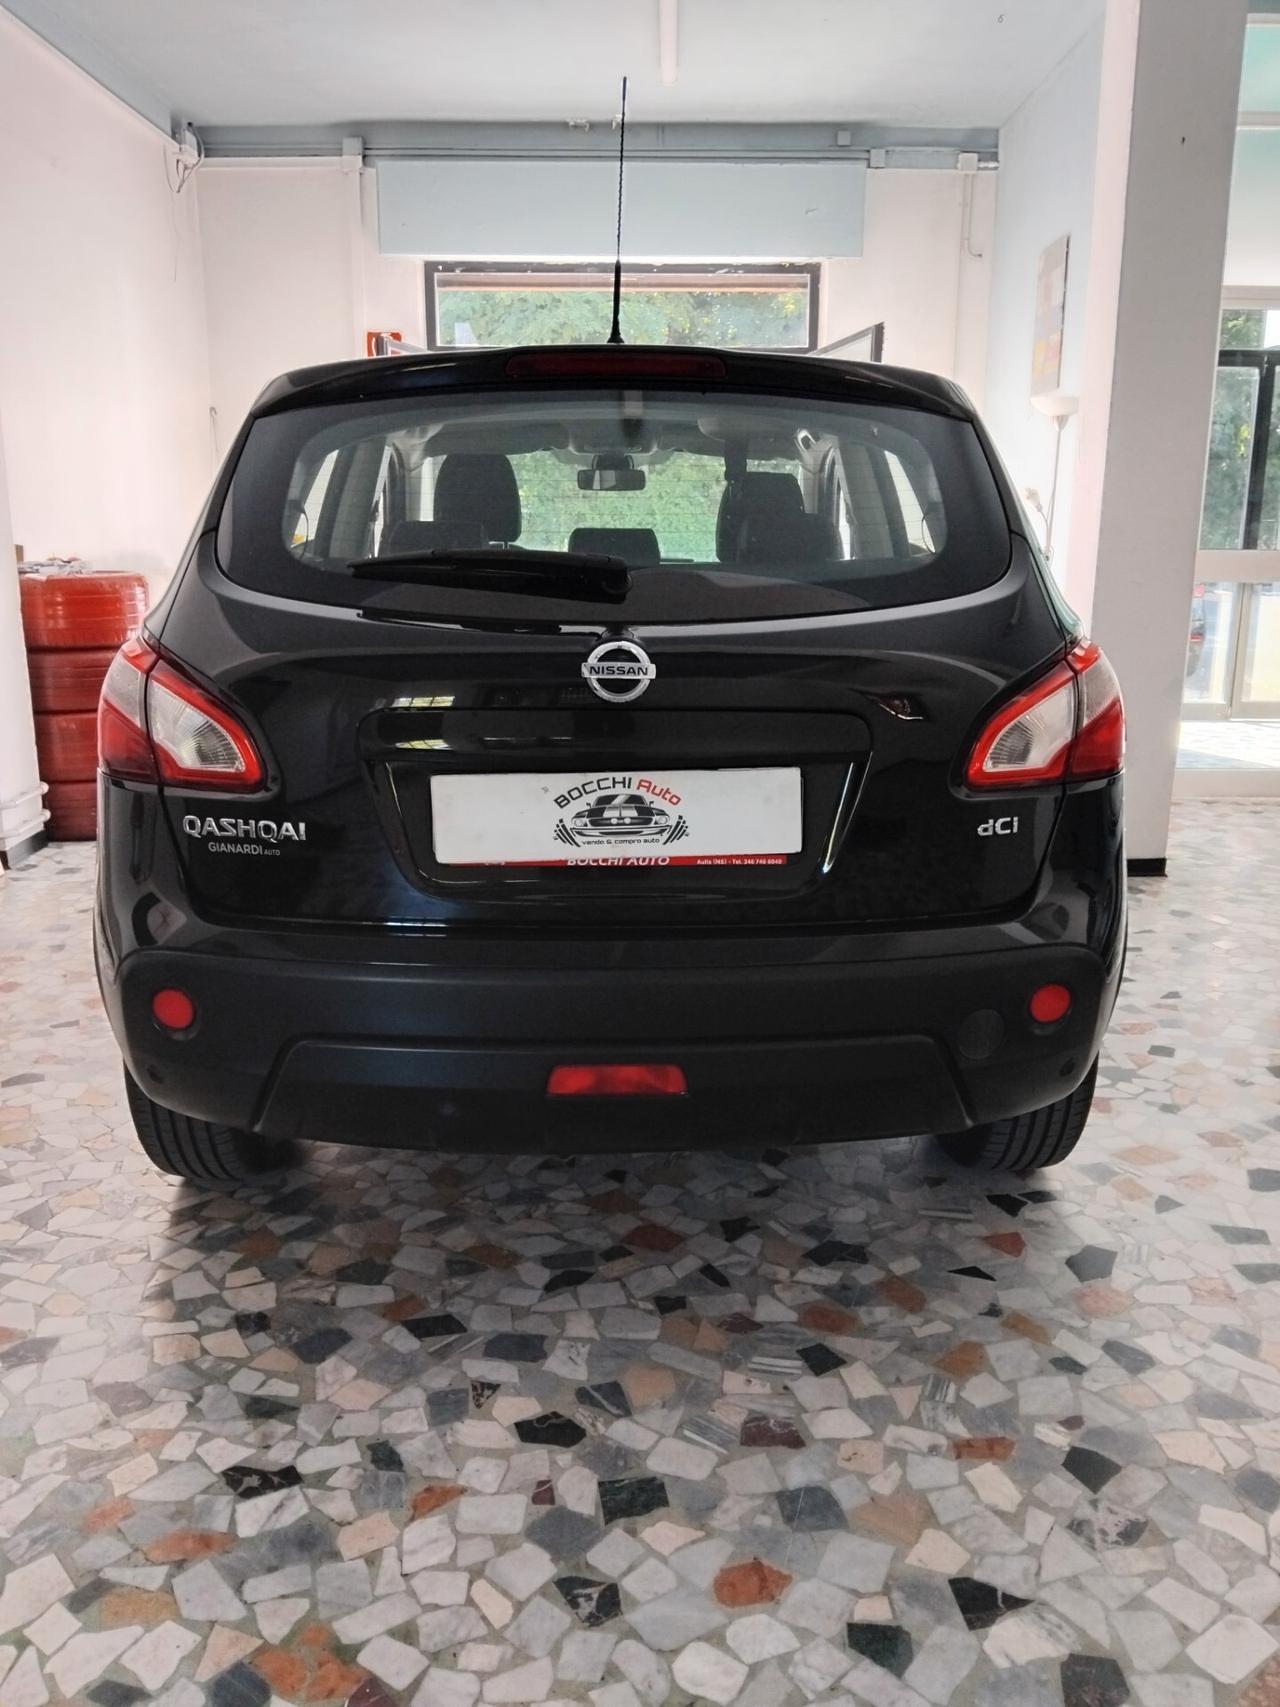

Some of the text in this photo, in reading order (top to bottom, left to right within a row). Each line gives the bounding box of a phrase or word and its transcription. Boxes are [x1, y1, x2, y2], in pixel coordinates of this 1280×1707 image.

[589, 666, 648, 676] NISSAN
[554, 776, 682, 809] BOCCHI Auto
[182, 815, 306, 843] QASHQAI
[208, 841, 281, 856] GIANARDI AUTO
[567, 856, 670, 866] BOCCHI AUTO
